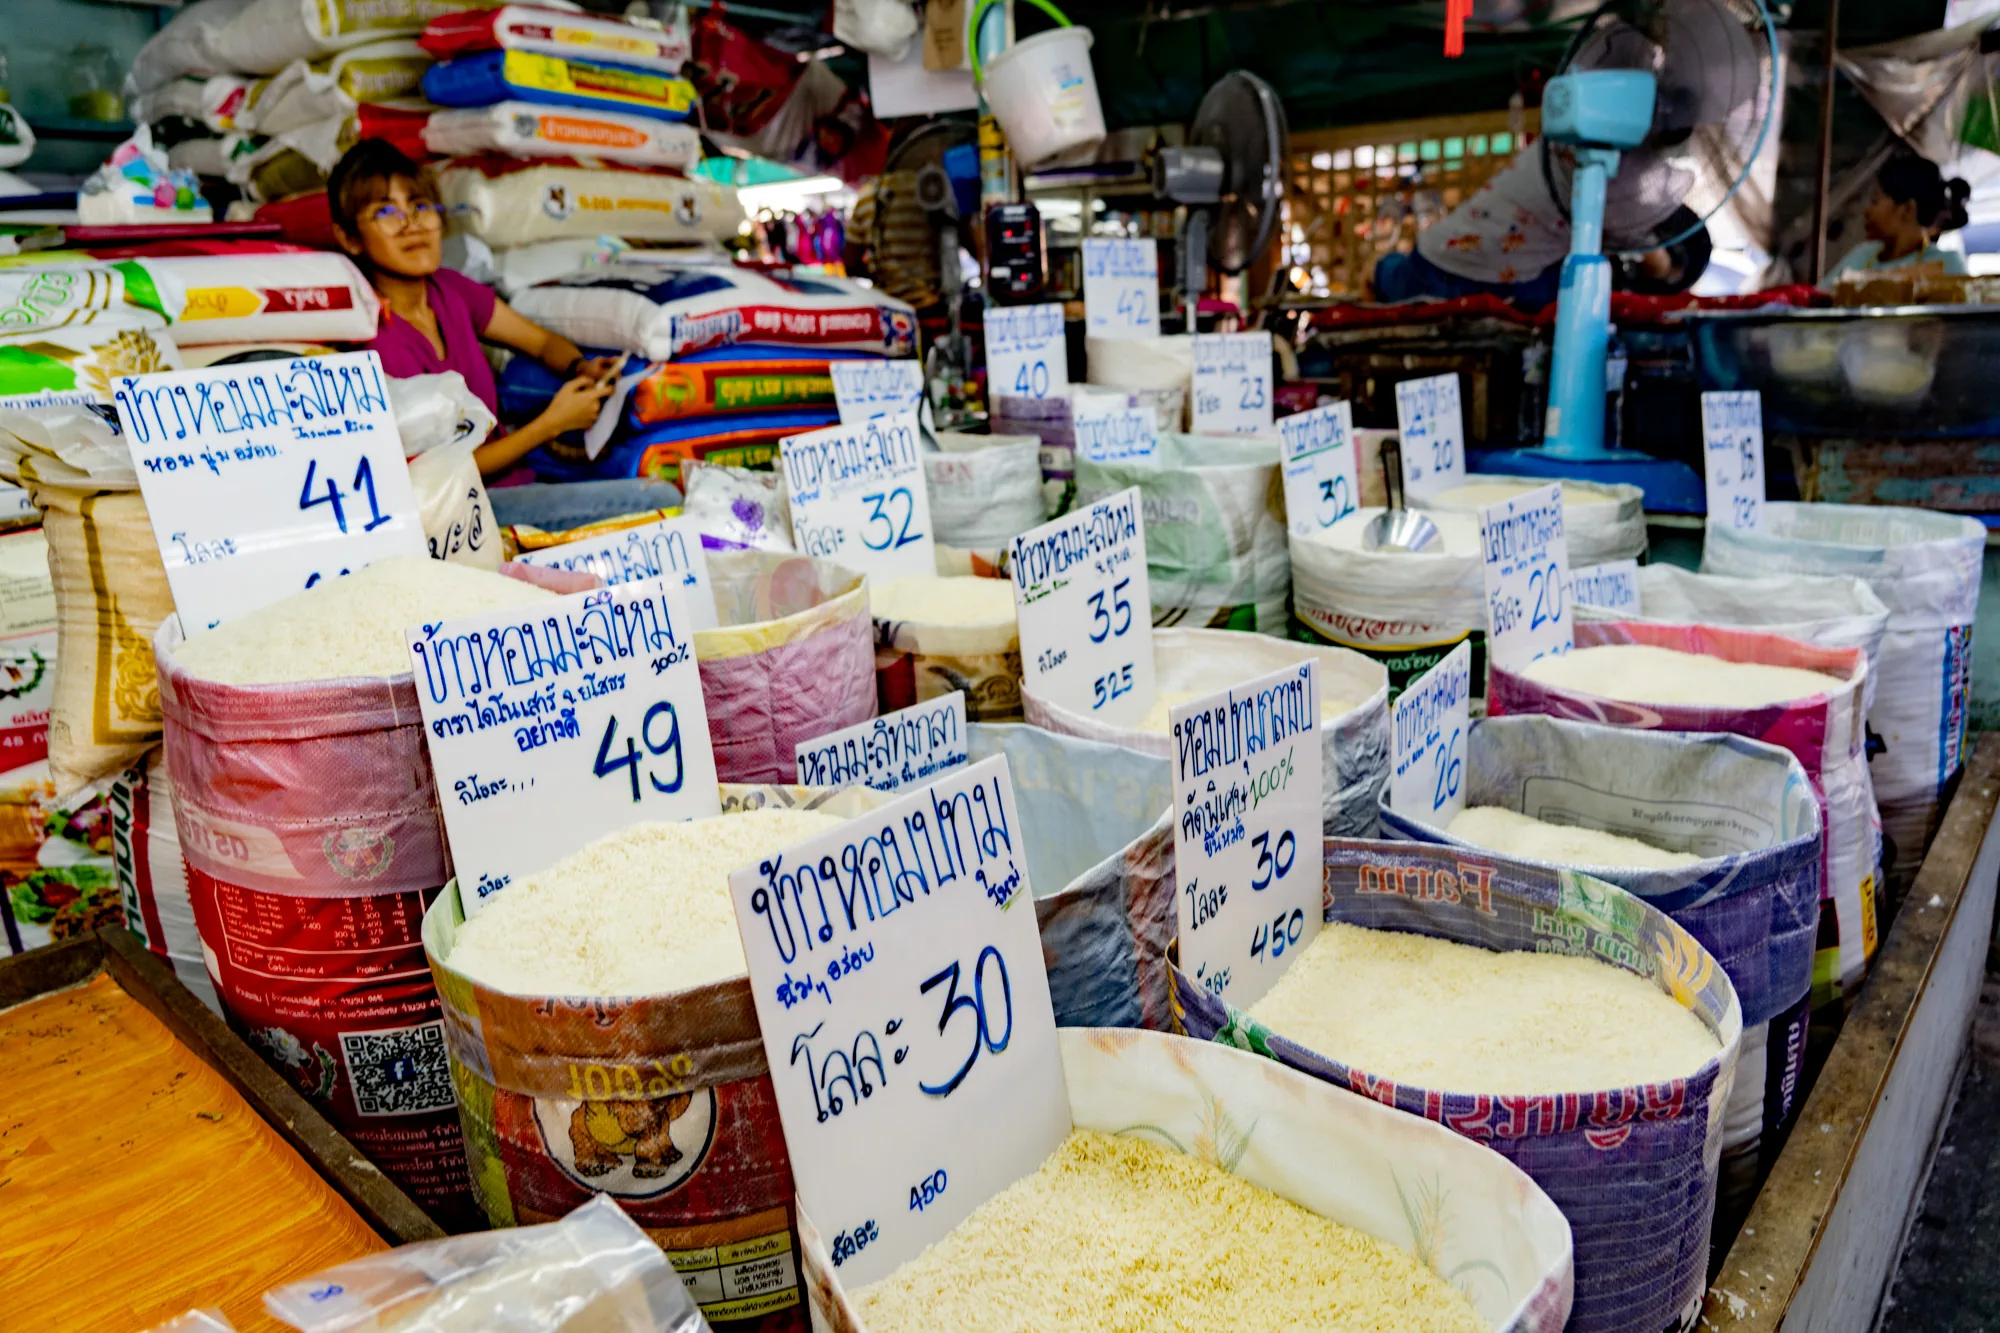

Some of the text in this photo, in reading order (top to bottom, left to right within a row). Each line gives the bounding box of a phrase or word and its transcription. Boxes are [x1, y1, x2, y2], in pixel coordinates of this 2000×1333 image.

[1015, 360, 1049, 400] 40
[1239, 376, 1265, 410] 23
[300, 455, 392, 534] 41
[861, 486, 924, 551] 32
[1317, 474, 1355, 528] 32
[1087, 577, 1132, 644] 35
[1529, 562, 1562, 632] 20
[650, 642, 690, 676] 100%
[1093, 663, 1135, 710] 525
[593, 700, 684, 803] 49
[1250, 745, 1294, 811] 100%
[1433, 727, 1461, 812] 26
[1251, 829, 1296, 891] 30
[1250, 908, 1304, 964] 450
[919, 946, 1012, 1098] 30
[908, 1168, 948, 1212] 450
